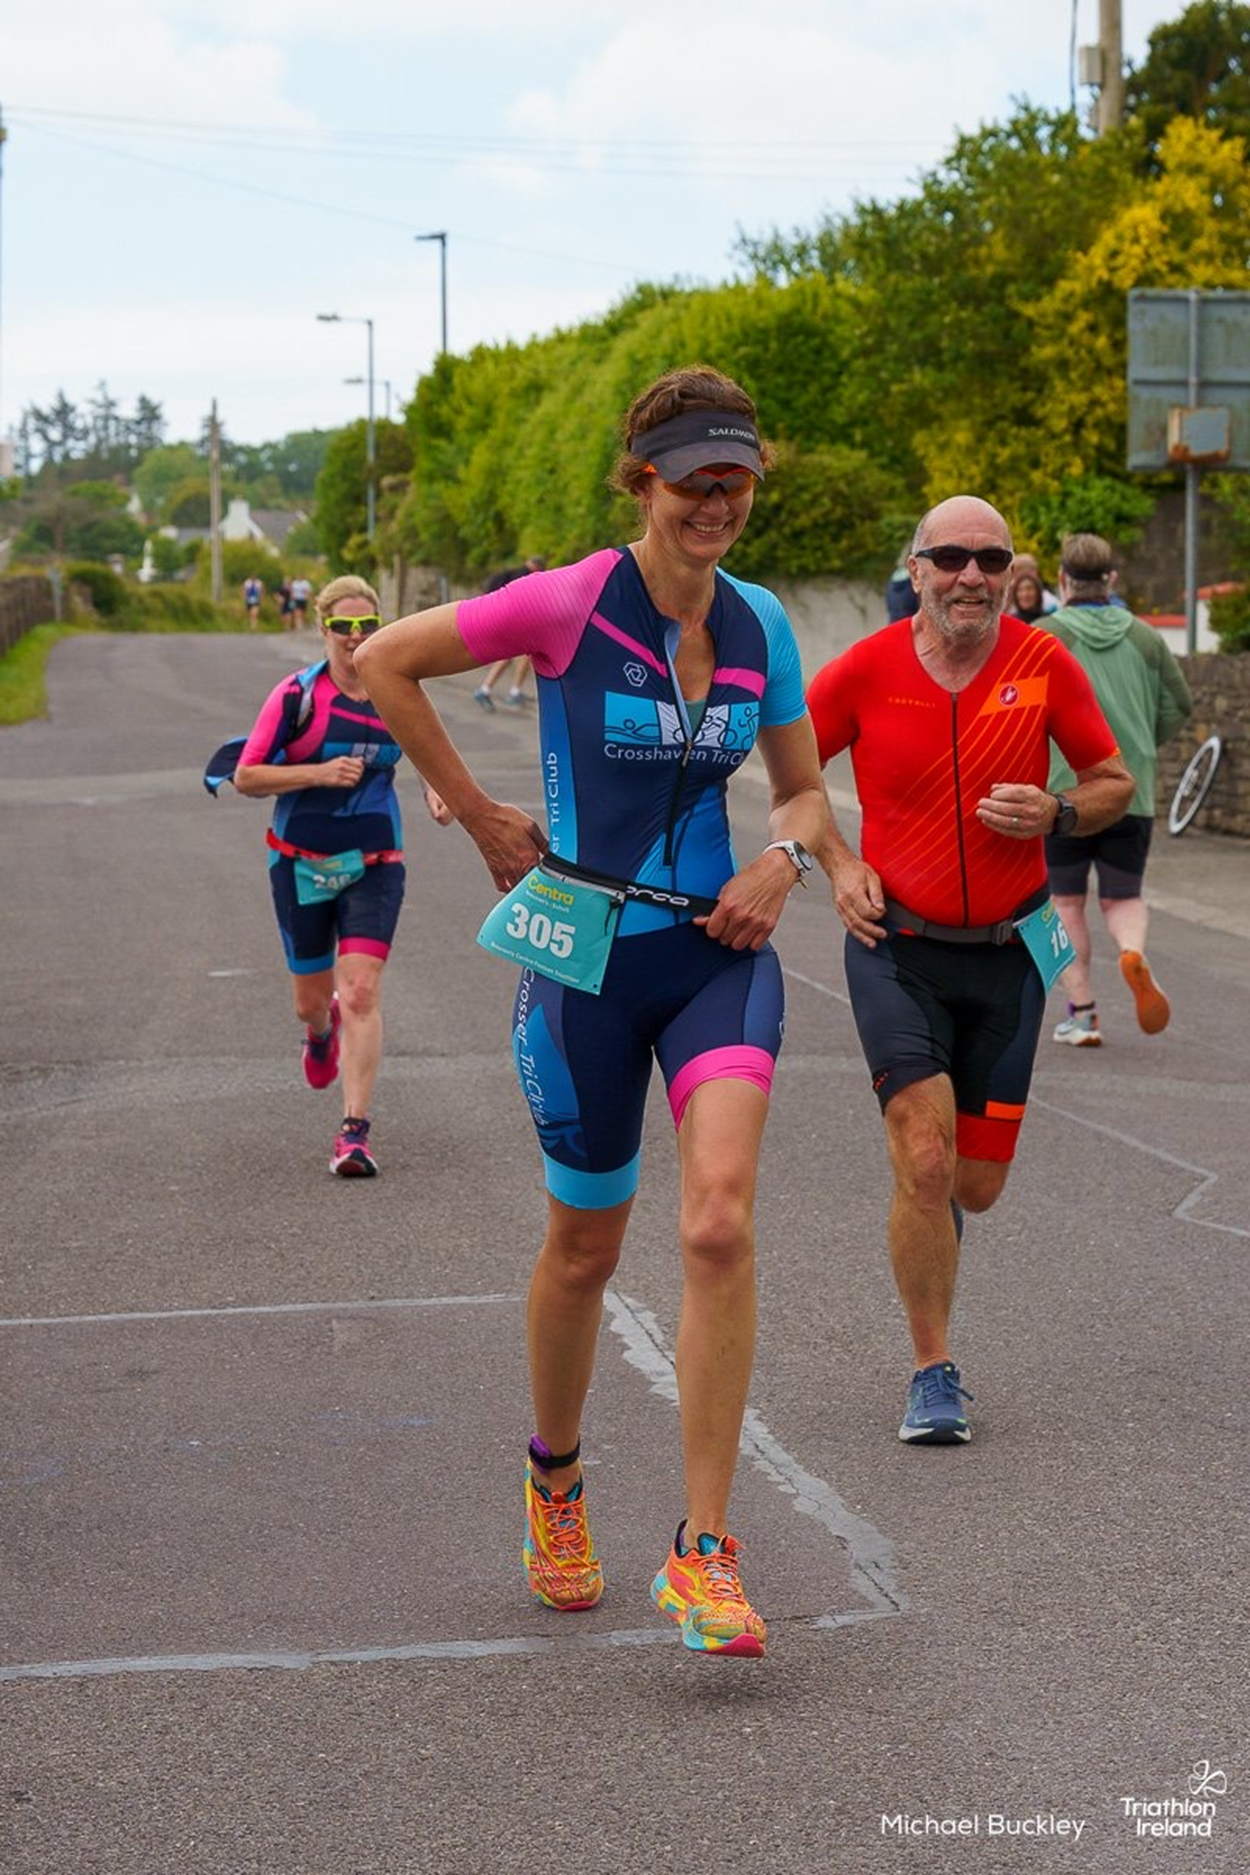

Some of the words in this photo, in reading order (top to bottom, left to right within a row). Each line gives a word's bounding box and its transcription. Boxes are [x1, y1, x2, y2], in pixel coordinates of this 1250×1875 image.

[604, 743, 707, 762] Crosshaven
[546, 752, 559, 798] Club
[549, 802, 560, 827] Tri
[528, 875, 575, 906] Centra
[506, 902, 577, 960] 305
[517, 966, 535, 1046] Crosser
[519, 1052, 538, 1080] Tri
